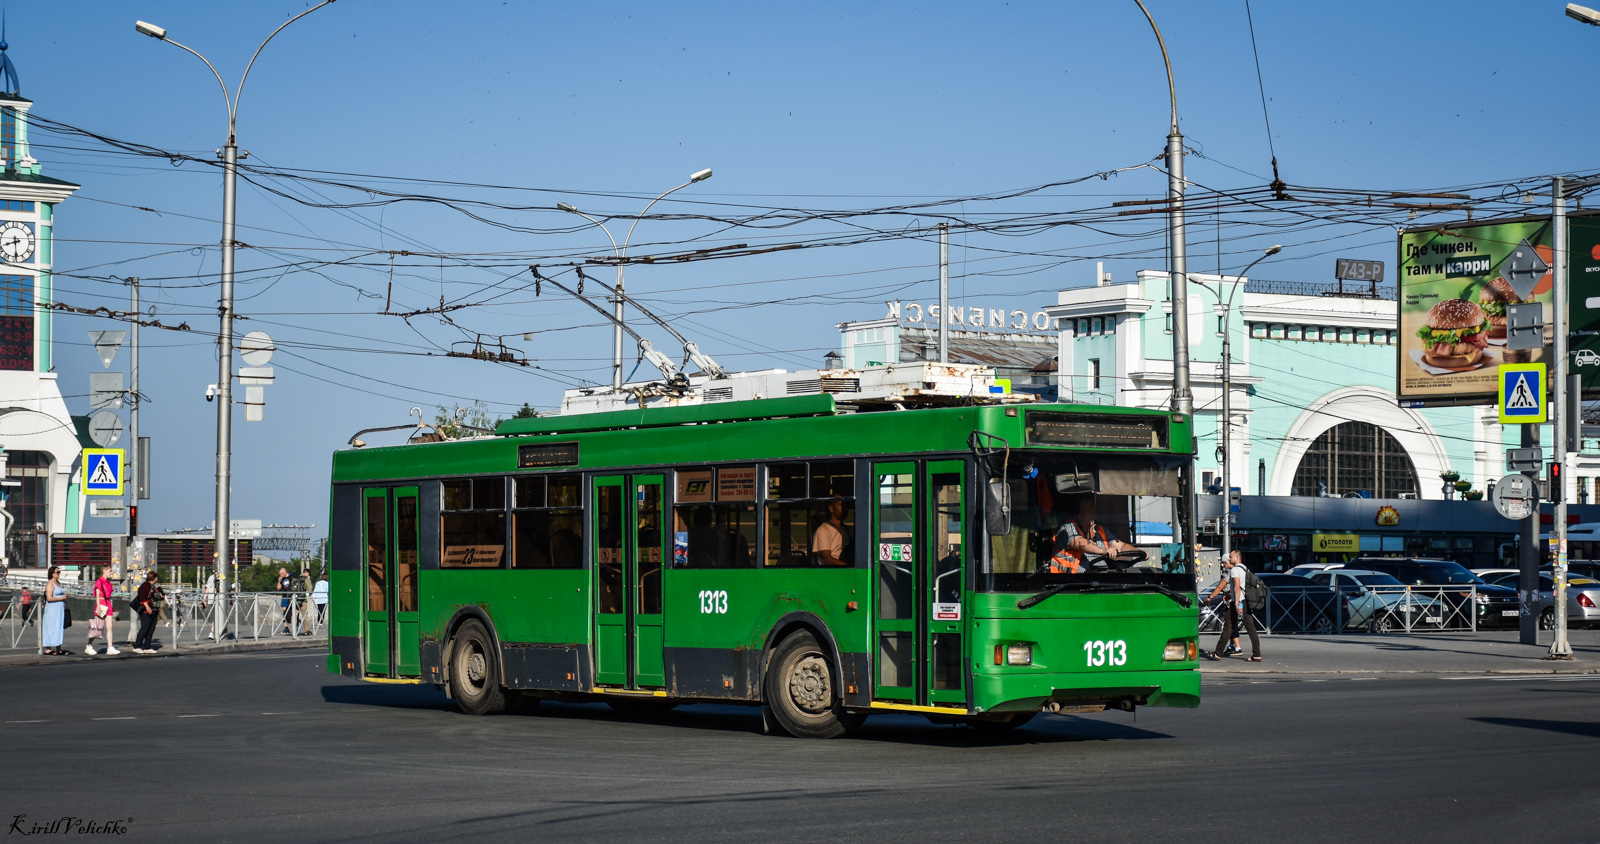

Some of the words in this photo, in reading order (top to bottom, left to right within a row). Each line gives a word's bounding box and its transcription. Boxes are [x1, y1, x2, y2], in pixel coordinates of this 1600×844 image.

[1407, 243, 1428, 258] Где
[1431, 241, 1477, 254] чикен,
[1406, 265, 1431, 276] там
[1435, 263, 1443, 274] и
[1447, 260, 1489, 275] карри
[462, 548, 475, 564] 23
[699, 590, 728, 614] 1313
[1084, 640, 1127, 667] 1313
